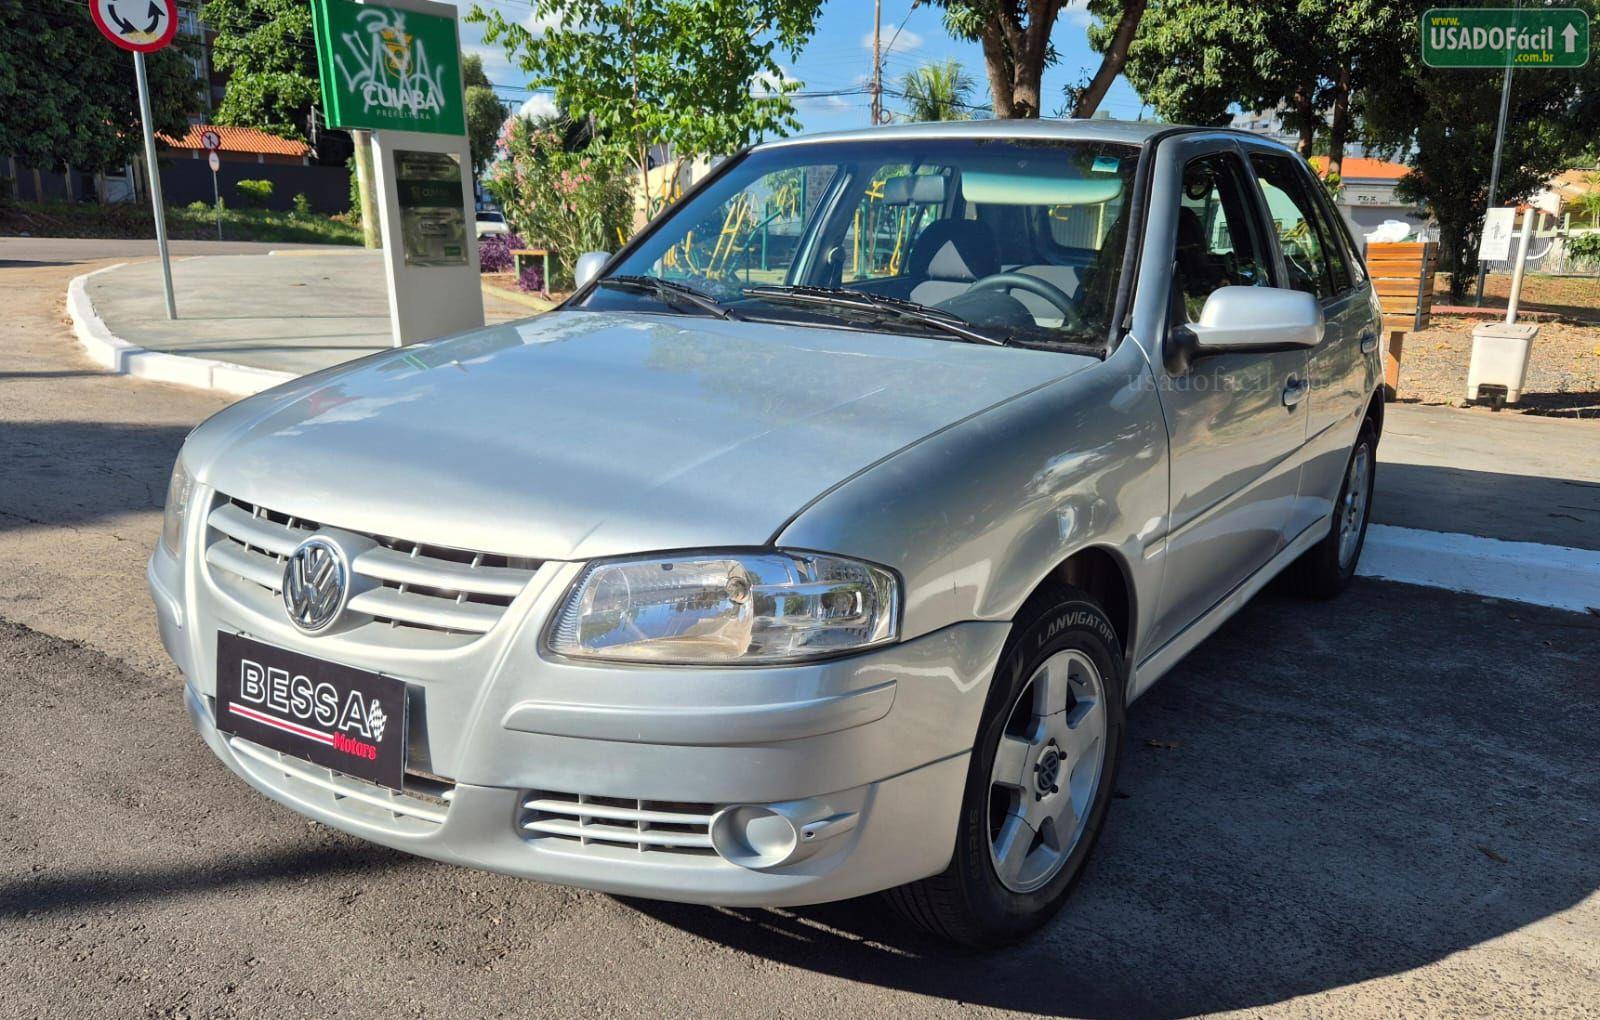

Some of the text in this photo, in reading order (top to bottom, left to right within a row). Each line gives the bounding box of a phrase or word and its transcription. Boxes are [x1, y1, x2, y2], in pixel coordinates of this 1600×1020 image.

[1037, 611, 1114, 649] LANVIGATOR
[241, 659, 372, 738] BESSA
[333, 731, 377, 761] Motors
